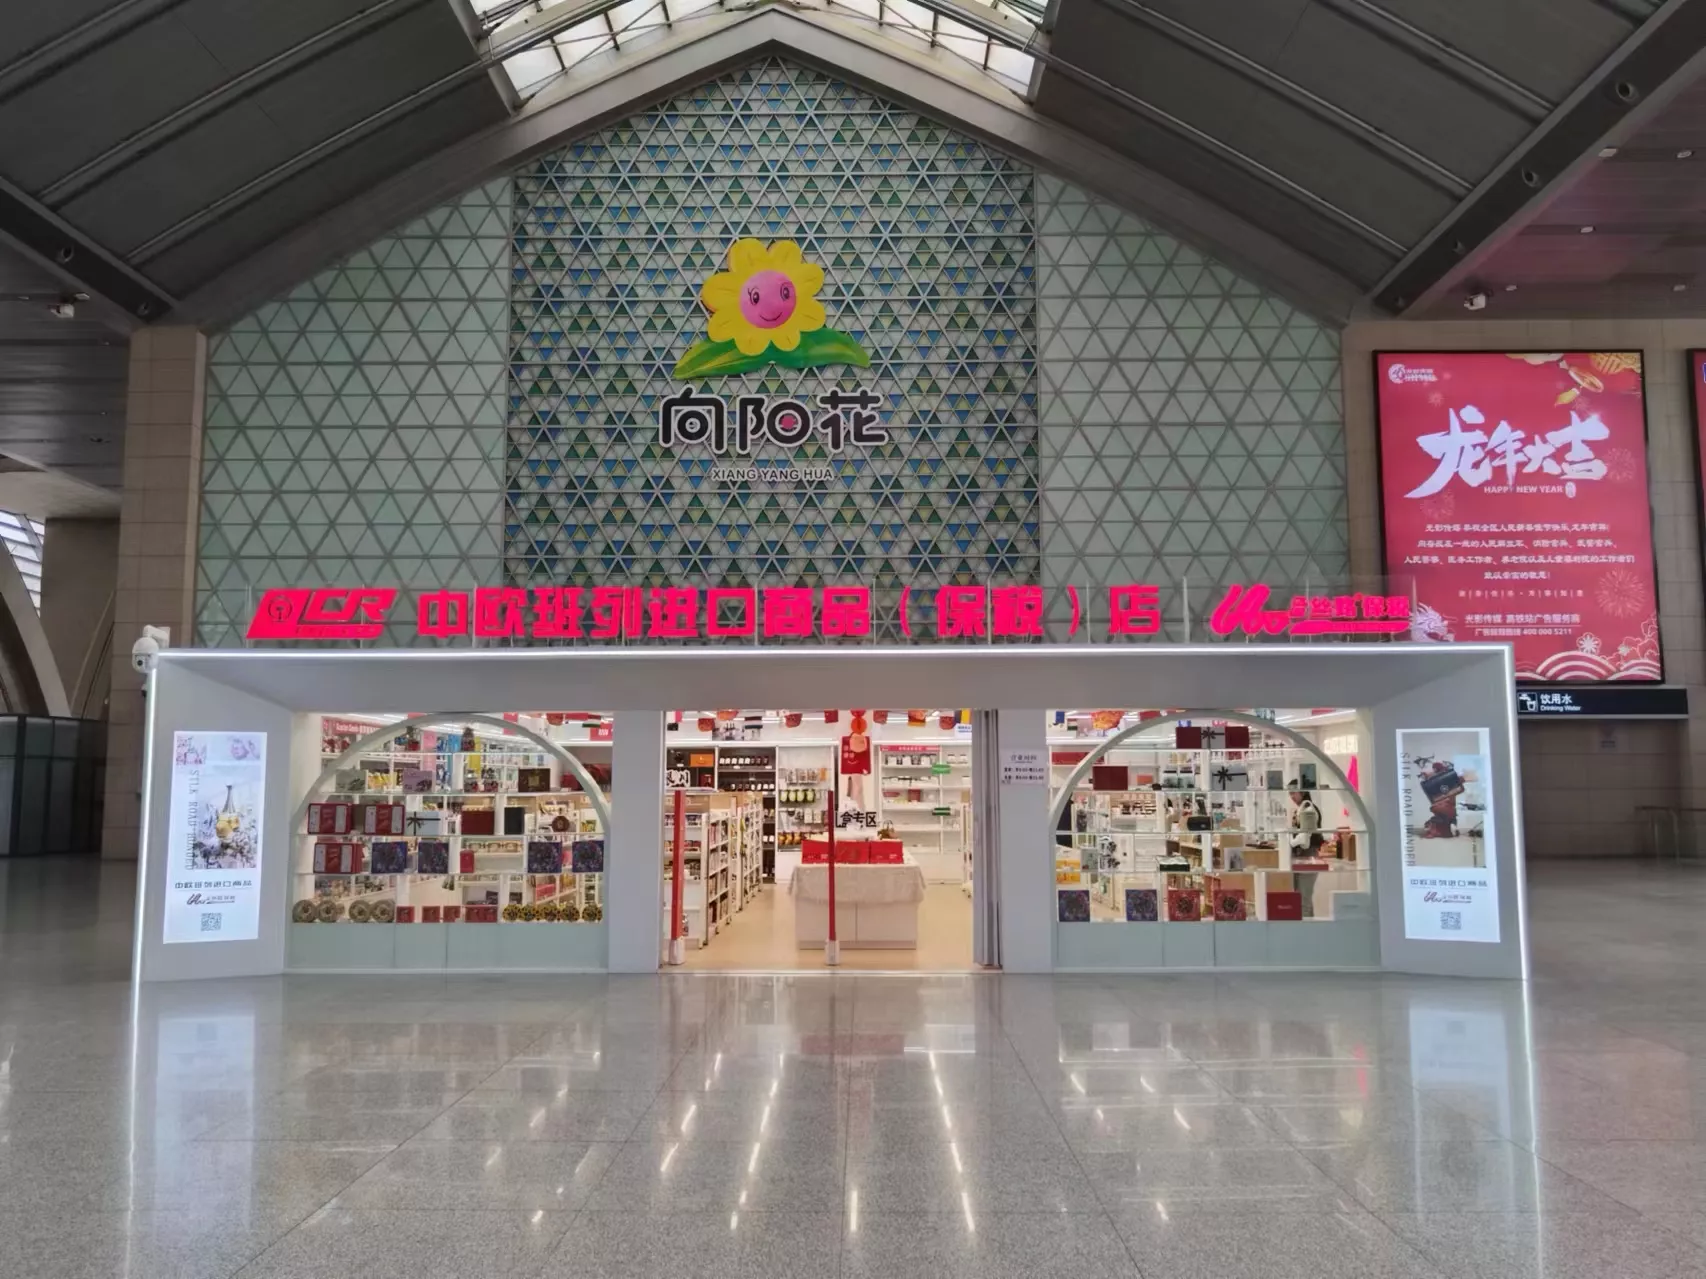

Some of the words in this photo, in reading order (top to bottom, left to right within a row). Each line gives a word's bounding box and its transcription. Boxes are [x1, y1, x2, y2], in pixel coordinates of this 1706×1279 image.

[660, 385, 888, 454] 向阳花
[1404, 405, 1610, 498] 龙年大吉
[713, 469, 756, 481] XIANG
[761, 469, 799, 481] YANG
[803, 469, 834, 481] HUA
[1540, 693, 1572, 704] 饮用水
[835, 810, 877, 828] 盒专区
